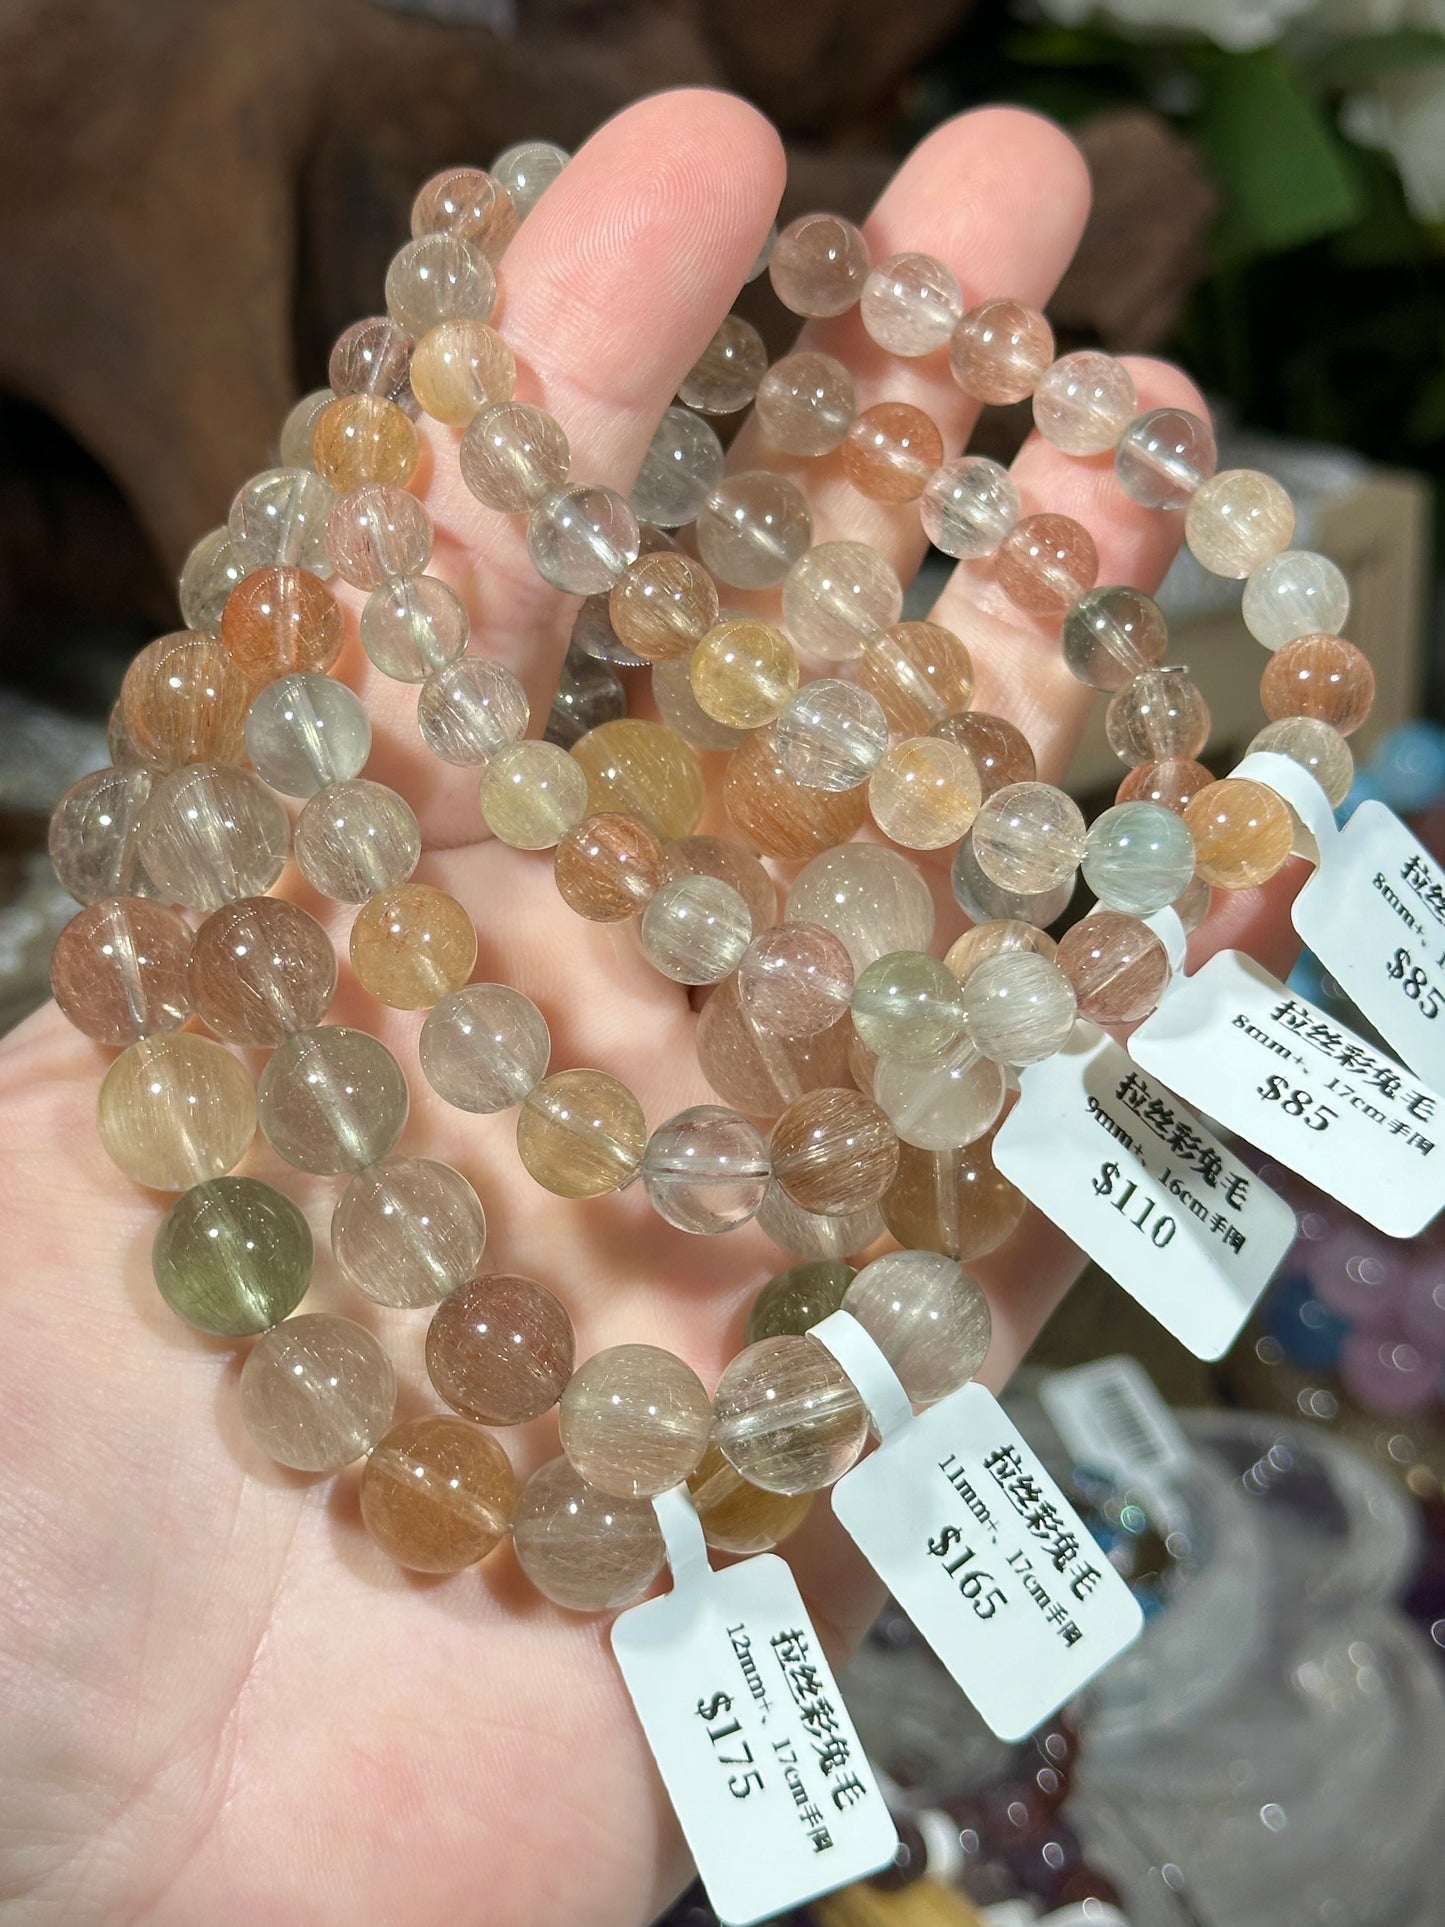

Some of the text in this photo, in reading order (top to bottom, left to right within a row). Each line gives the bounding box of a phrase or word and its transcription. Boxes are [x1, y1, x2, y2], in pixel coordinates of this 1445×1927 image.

[1386, 947, 1445, 1019] $85
[1256, 1074, 1339, 1131] $85
[1270, 1000, 1436, 1123] 拉丝彩兔毛
[1115, 1072, 1249, 1211] 拉丝彩兔毛
[1092, 1162, 1176, 1248] $110
[927, 1525, 1008, 1619] $165
[983, 1444, 1102, 1601] 拉丝彩兔毛
[695, 1690, 764, 1799] $175
[770, 1628, 867, 1811] 拉丝彩兔毛
